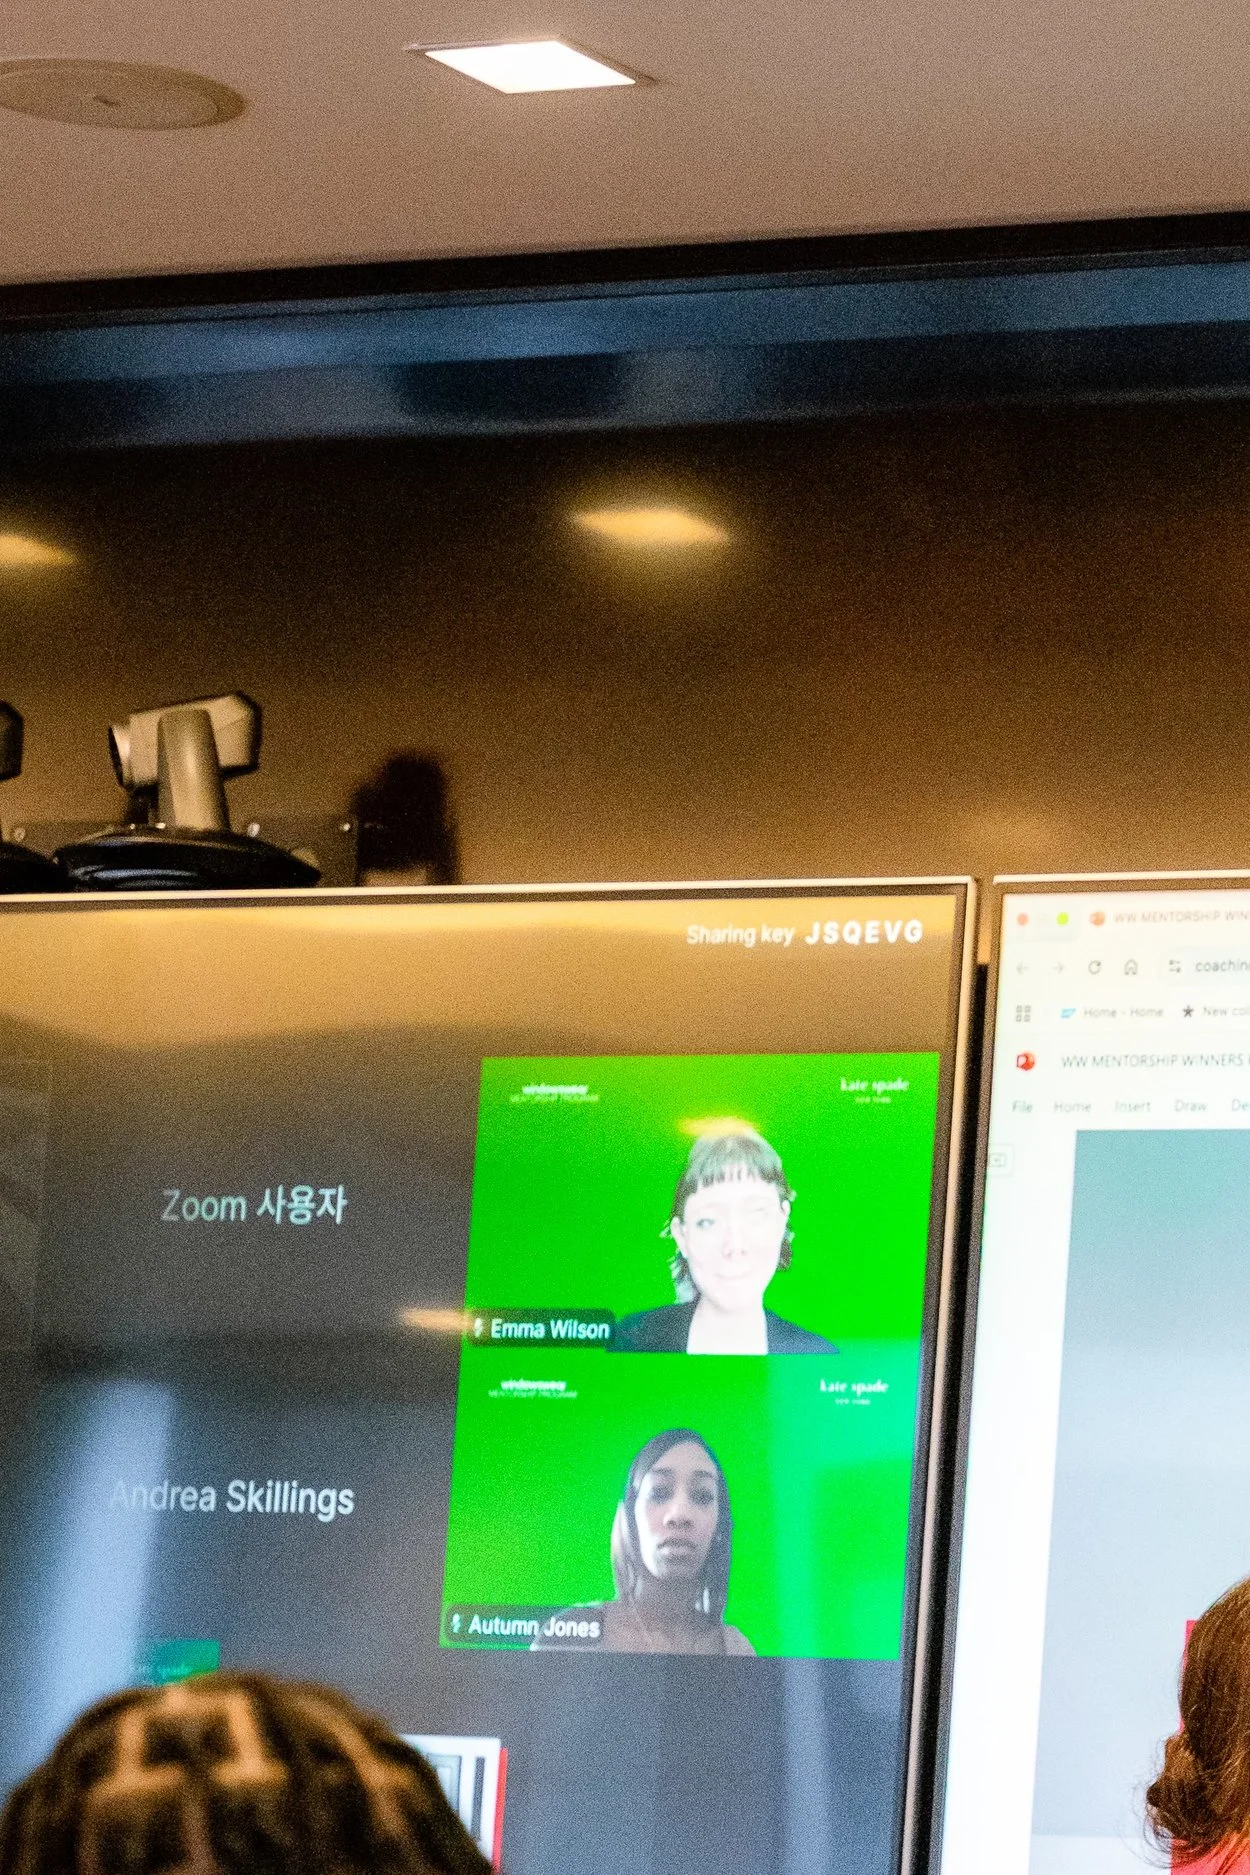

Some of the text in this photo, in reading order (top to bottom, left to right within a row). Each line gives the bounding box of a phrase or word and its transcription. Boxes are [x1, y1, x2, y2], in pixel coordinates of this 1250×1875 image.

[686, 919, 924, 948] Sharing key JSQEVG
[1083, 1006, 1117, 1019] Home
[1130, 1006, 1164, 1018] Home
[1203, 1005, 1228, 1017] New
[1061, 1055, 1088, 1068] WW
[1091, 1053, 1178, 1068] MENTORSHIP
[1181, 1053, 1244, 1068] WINNERS
[1012, 1100, 1033, 1113] File
[1054, 1099, 1091, 1113] Home
[1114, 1098, 1151, 1113] Insert
[1174, 1098, 1207, 1112] Draw
[161, 1184, 348, 1225] Zoom 사용자
[491, 1318, 611, 1340] Emma Wilson
[111, 1478, 355, 1523] Andrea Skillings
[468, 1613, 601, 1638] Autumn Jones
